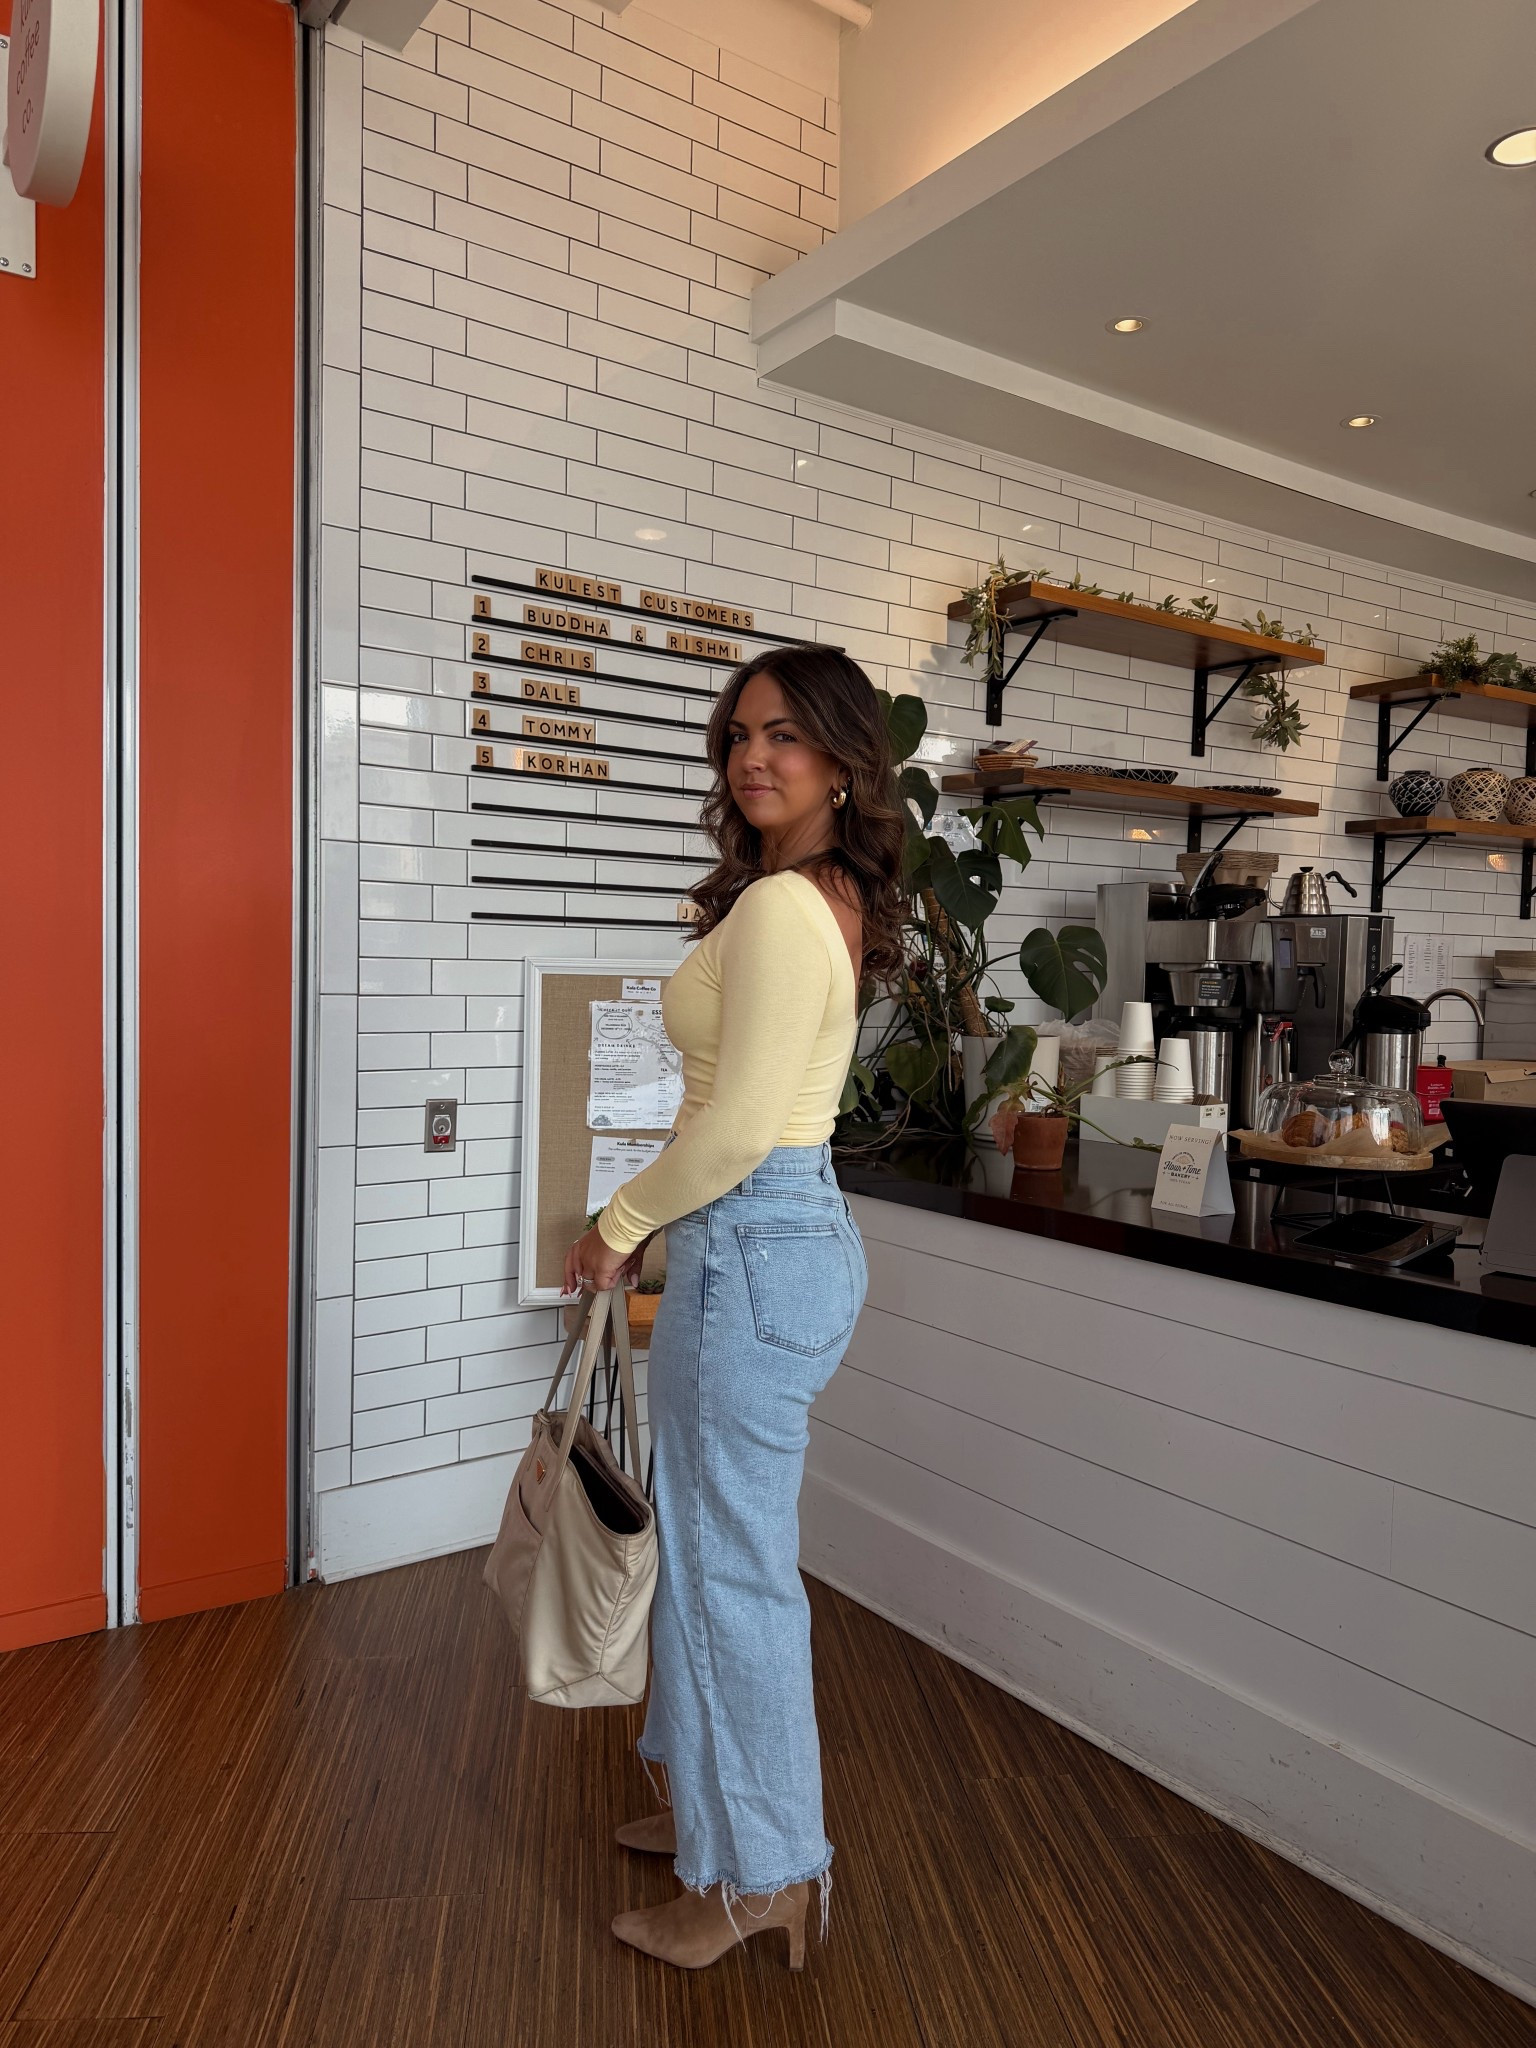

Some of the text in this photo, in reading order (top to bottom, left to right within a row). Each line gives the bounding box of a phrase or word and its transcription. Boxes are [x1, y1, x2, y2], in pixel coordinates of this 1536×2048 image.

[16, 19, 41, 95] coffee
[22, 97, 34, 135] co.
[538, 572, 754, 628] KULEST CUSTOMERS
[478, 600, 740, 660] 1 BUDDHA & RISHMI
[477, 637, 592, 670] 2 CHRIS
[477, 675, 578, 704] 3 DALE
[477, 712, 594, 741] 4 TOMMY
[480, 749, 609, 778] 5 KORHAN
[1185, 1164, 1202, 1175] Time
